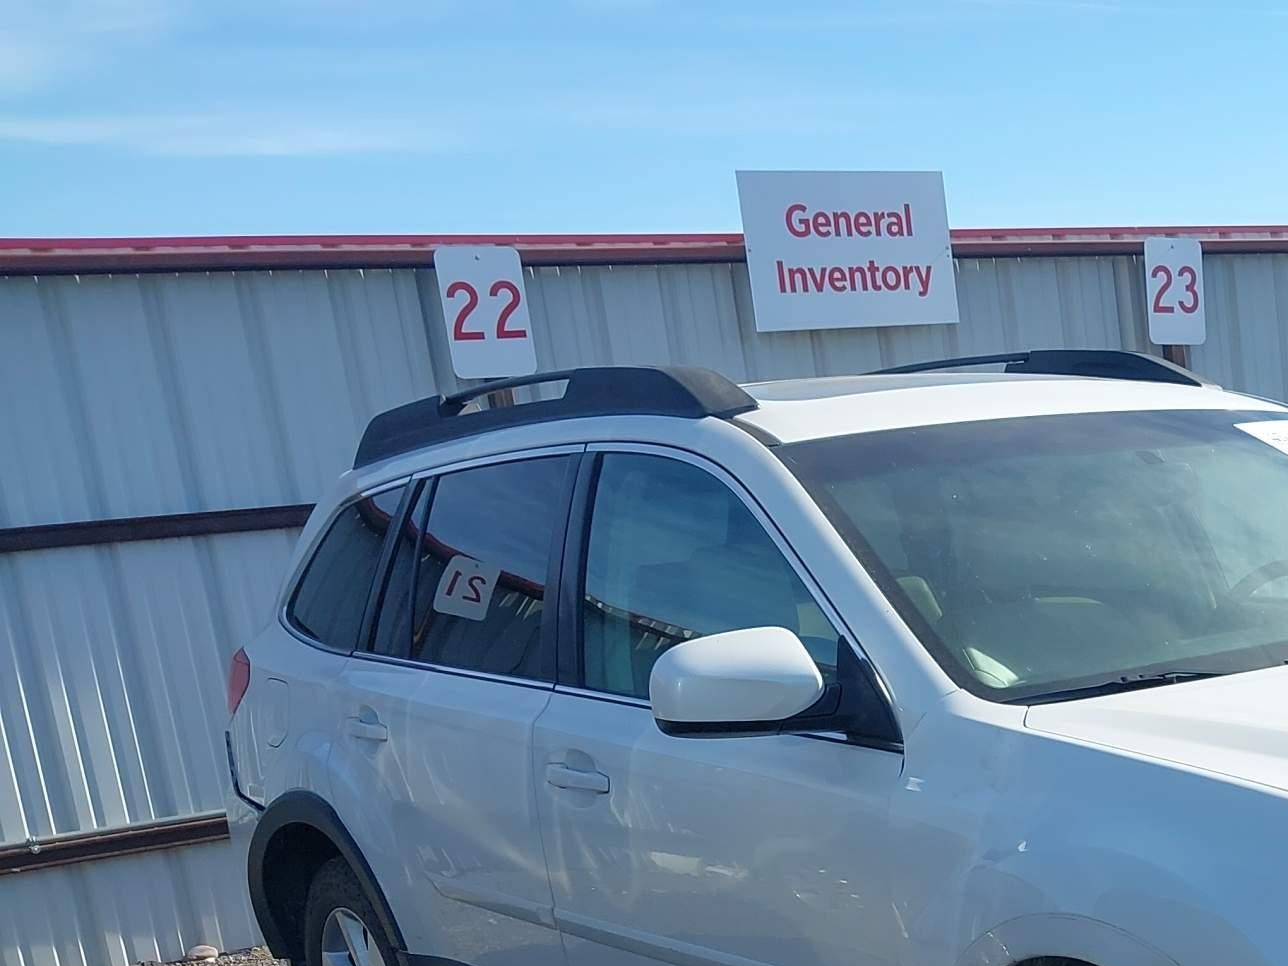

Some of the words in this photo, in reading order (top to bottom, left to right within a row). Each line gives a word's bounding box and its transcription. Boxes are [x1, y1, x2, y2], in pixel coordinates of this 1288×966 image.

[786, 204, 912, 238] General
[776, 260, 932, 297] Inventory
[1152, 266, 1198, 314] 23
[447, 281, 527, 341] 22
